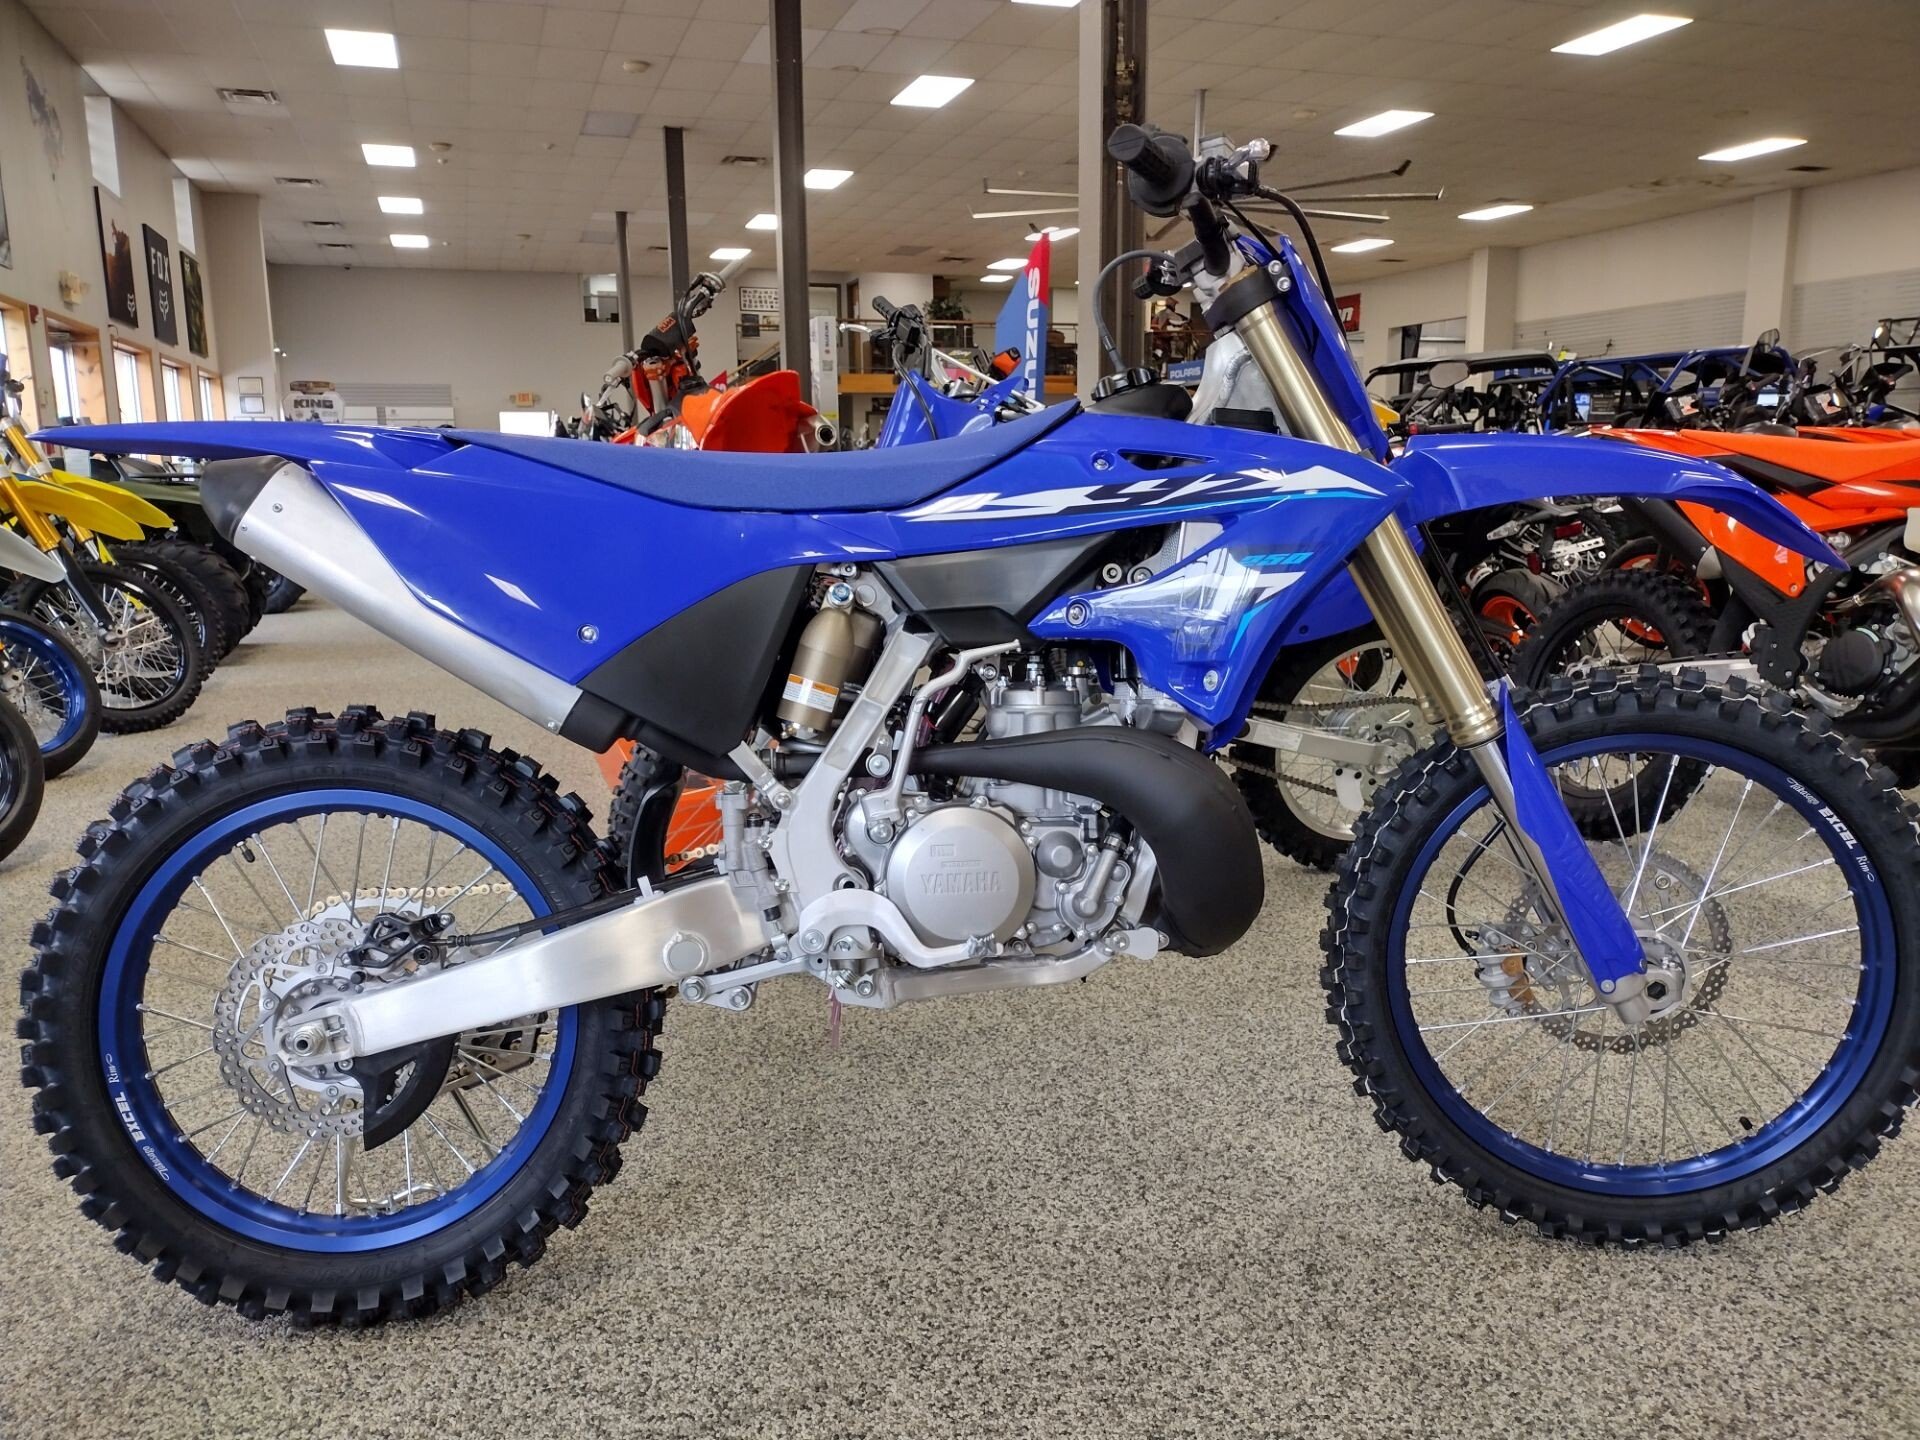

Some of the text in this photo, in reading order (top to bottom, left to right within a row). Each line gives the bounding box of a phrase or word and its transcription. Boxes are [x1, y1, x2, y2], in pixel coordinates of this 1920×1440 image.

[150, 247, 170, 285] FOX
[294, 399, 334, 409] KING
[1241, 552, 1314, 566] 250
[1818, 806, 1858, 850] EXCEL
[1856, 856, 1873, 877] Rim
[920, 871, 1002, 896] YAMAHA
[106, 1058, 120, 1083] Rim
[115, 1092, 146, 1142] EXCEL
